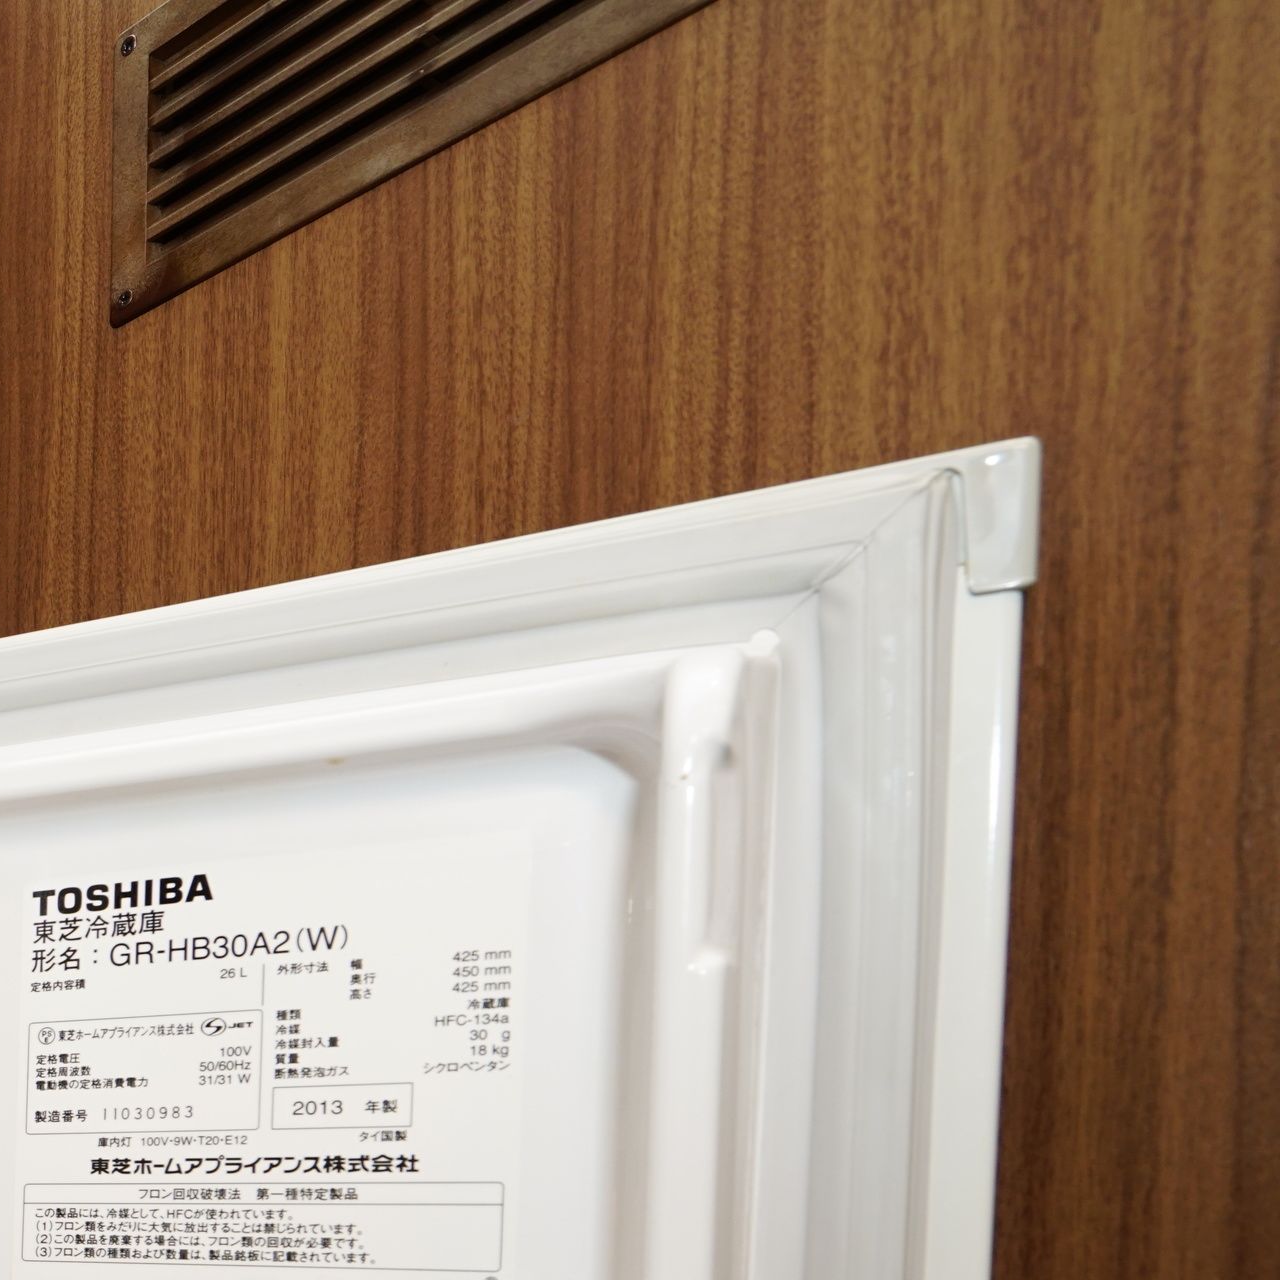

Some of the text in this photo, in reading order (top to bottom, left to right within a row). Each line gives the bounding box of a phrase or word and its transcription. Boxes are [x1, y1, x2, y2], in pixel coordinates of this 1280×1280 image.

[32, 874, 213, 916] TOSHIBA
[33, 910, 165, 944] 東芝冷蔵庫
[277, 949, 512, 975] 外形寸法 幅 425 mm
[30, 967, 248, 993] 定格内容積 26 L
[350, 965, 512, 985] 奥行 450 mm
[349, 980, 511, 1000] 高さ 425 mm
[276, 997, 510, 1021] 種類 冷蔵庫
[58, 1021, 254, 1042] 東芝ホームアプライアンス株式会社 JET
[276, 1013, 509, 1035] 冷媒 HFC-134a
[275, 1029, 511, 1050] 冷媒封入量 30 g
[36, 1046, 252, 1066] 定格電圧 100V
[275, 1044, 509, 1065] 質量 18 kg
[35, 1061, 251, 1078] 定格周波数 50/60Hz
[274, 1065, 350, 1080] 断熱発泡ガス
[35, 1074, 251, 1091] 電動機の定格消費電力 31/31 W
[34, 1109, 88, 1123] 製造番号
[292, 1099, 398, 1116] 2013 年製
[97, 1137, 132, 1148] 庫内灯
[359, 1130, 408, 1142] タイ国製
[90, 1154, 420, 1175] 東芝ホームアプライアンス株式会社
[139, 1188, 359, 1201] フロン回収破壊法 第一種特定製品
